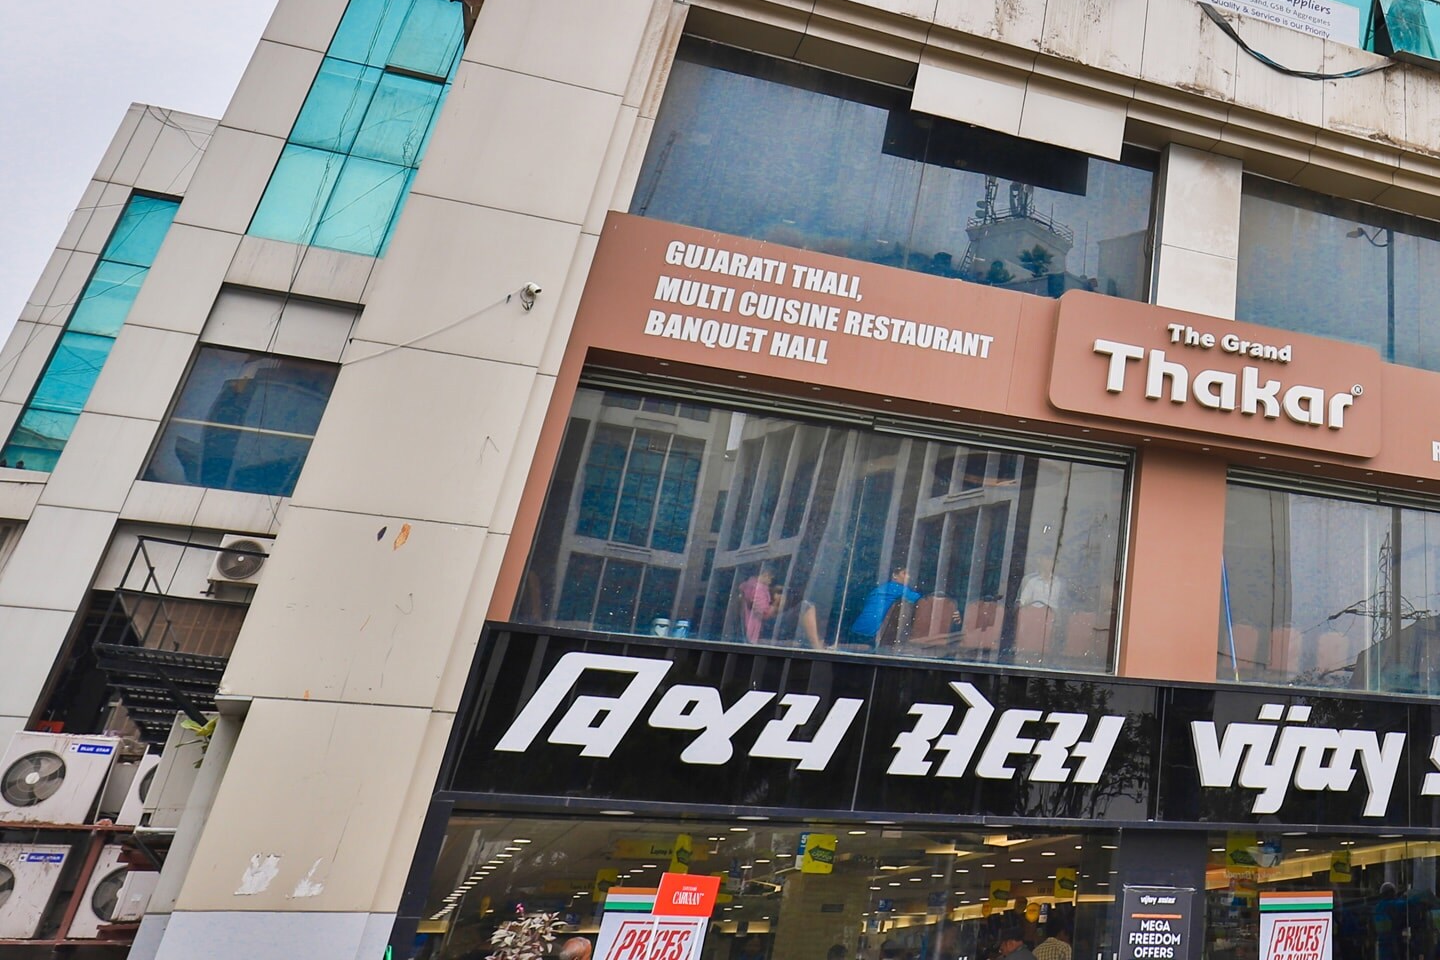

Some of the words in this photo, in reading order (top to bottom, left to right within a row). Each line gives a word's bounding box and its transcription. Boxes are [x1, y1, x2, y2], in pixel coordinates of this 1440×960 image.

[1242, 5, 1249, 14] &
[1251, 8, 1281, 23] Service
[1290, 20, 1304, 31] our
[1304, 24, 1330, 39] Priority
[1270, 2, 1285, 12] GSB
[1293, 9, 1331, 26] Aggregates
[664, 239, 787, 286] GUJARATI
[792, 262, 863, 302] THALI,
[653, 275, 735, 314] MULTI
[738, 290, 839, 333] CUISINE
[844, 314, 994, 359] RESTAURANT
[643, 309, 768, 354] BANQUET
[769, 333, 829, 366] HALL
[1168, 322, 1215, 350] The
[1220, 331, 1293, 364] Grand
[1093, 337, 1354, 431] Thakar
[494, 651, 864, 771] વિજય
[1191, 703, 1406, 817] vijay
[613, 929, 692, 960] PRCES
[1128, 932, 1181, 945] FREEDOM
[1140, 919, 1171, 932] MEGA
[1273, 924, 1322, 953] PRICES
[1133, 946, 1174, 959] OFFERS
